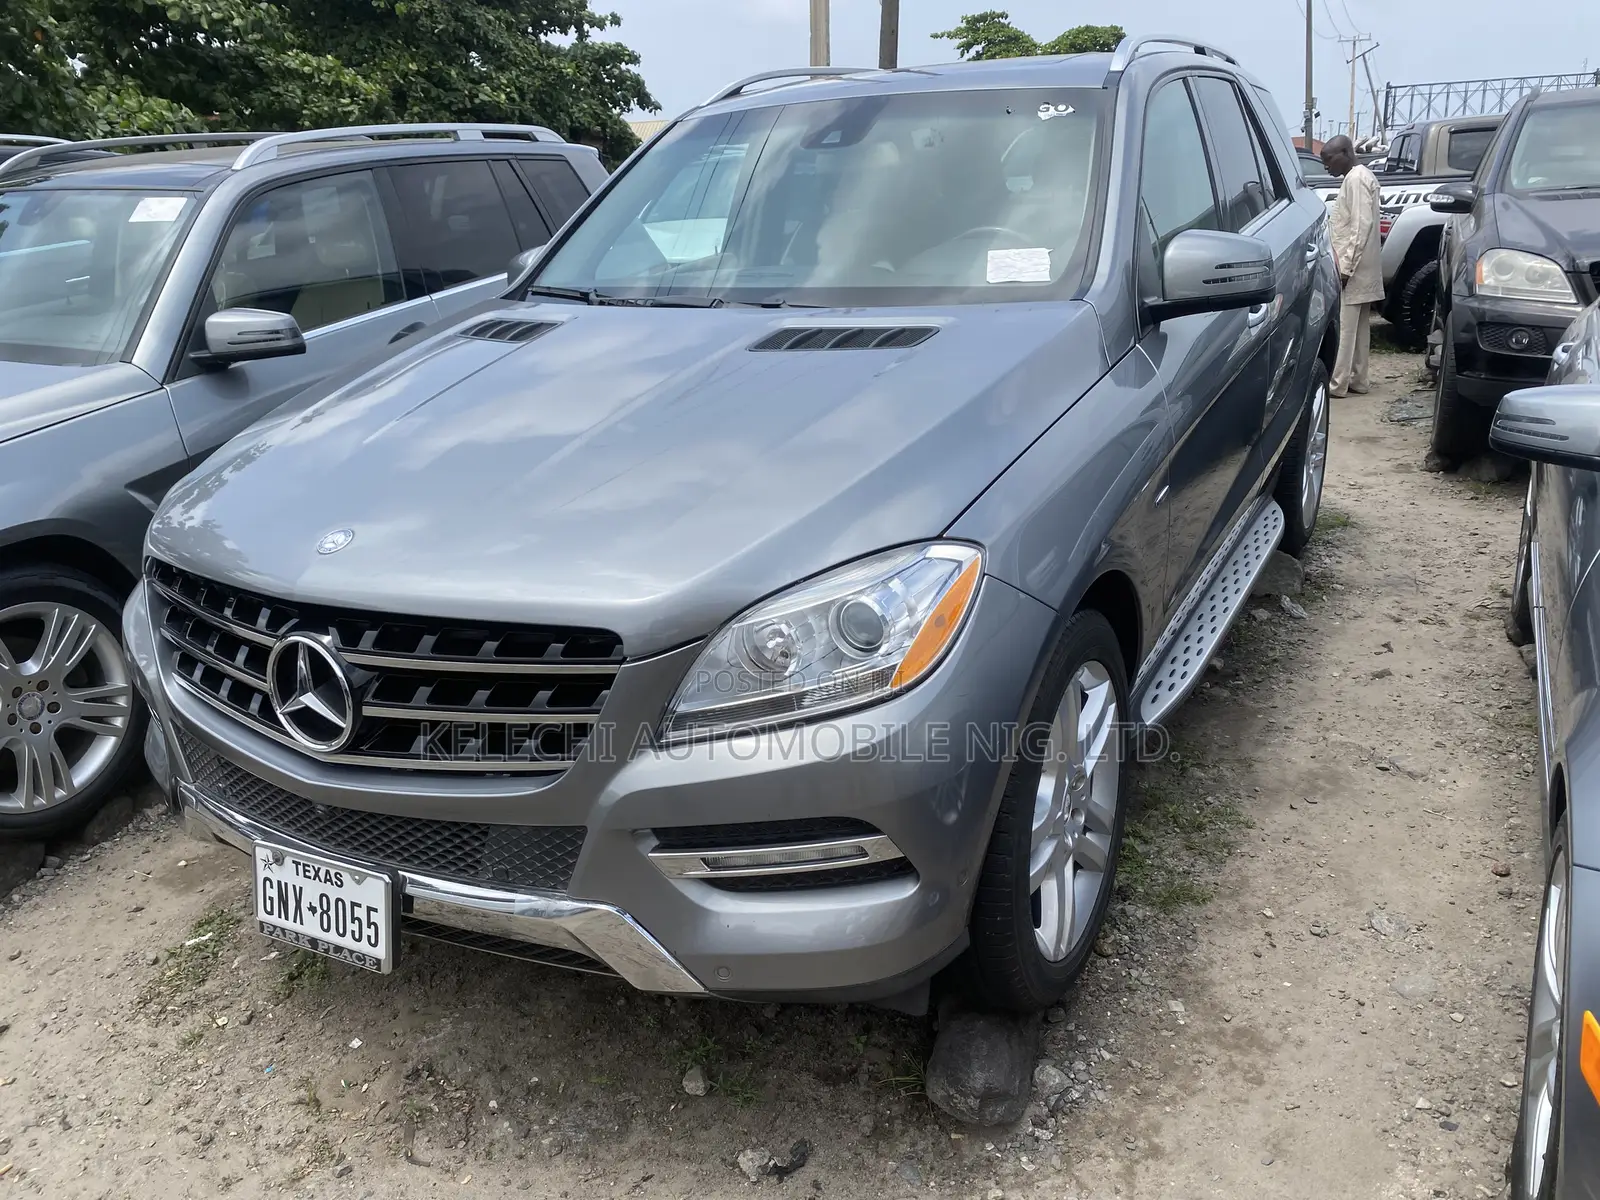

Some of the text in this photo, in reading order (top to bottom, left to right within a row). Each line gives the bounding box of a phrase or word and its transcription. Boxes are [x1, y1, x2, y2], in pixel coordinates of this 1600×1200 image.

[292, 860, 344, 888] TEXAS
[318, 892, 379, 948] 8055
[262, 923, 378, 970] PARK PLACE
